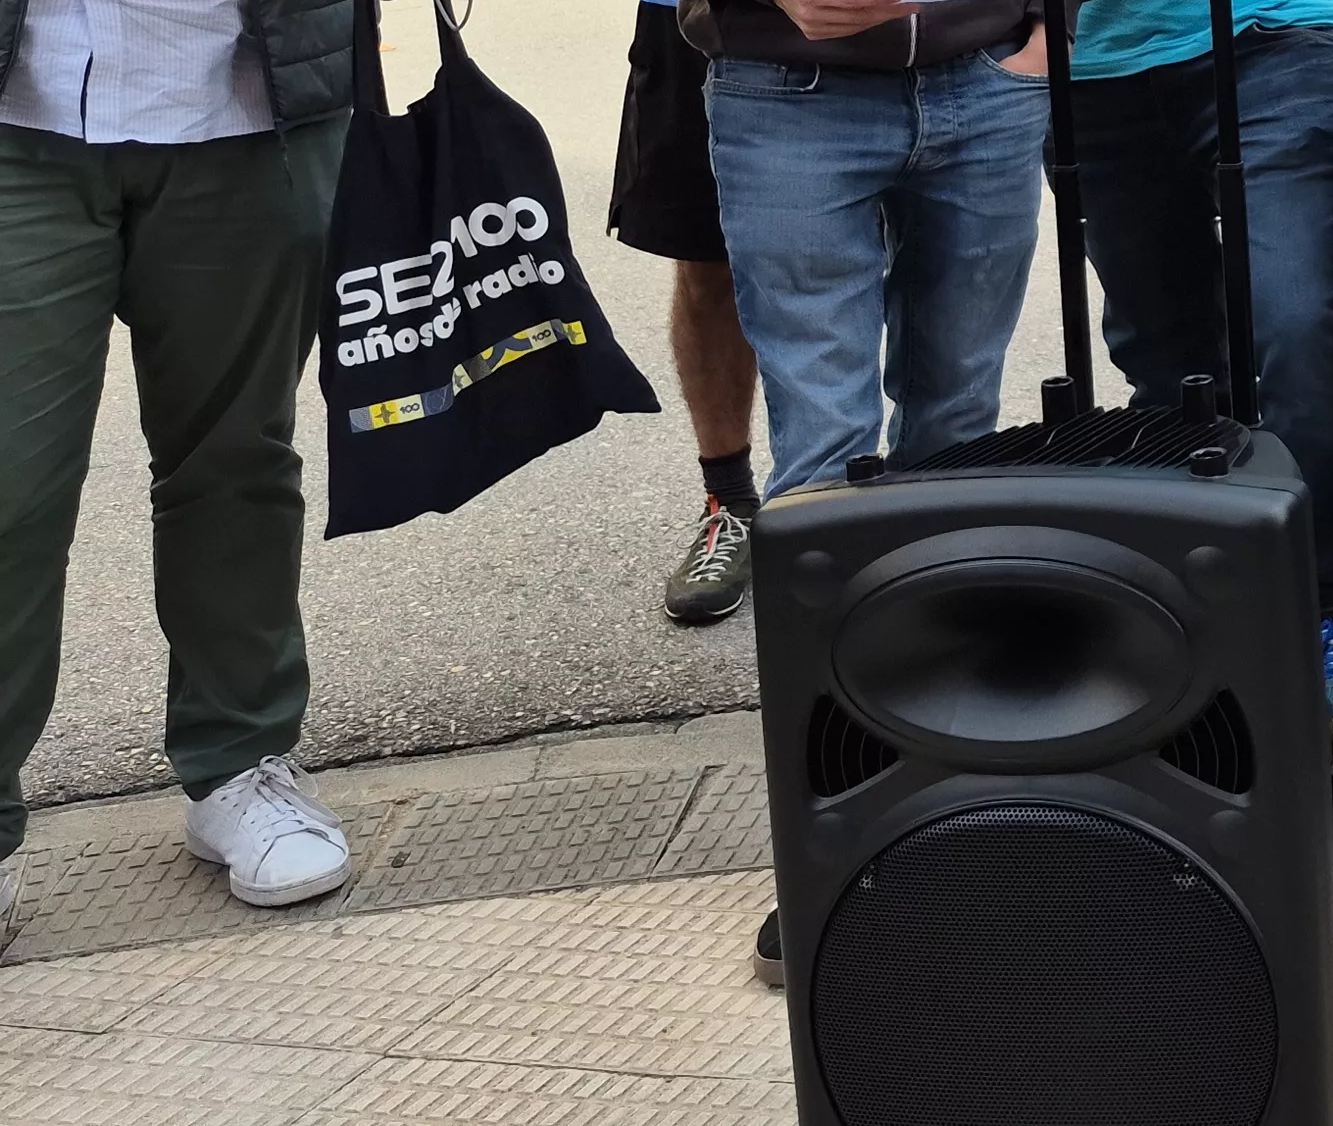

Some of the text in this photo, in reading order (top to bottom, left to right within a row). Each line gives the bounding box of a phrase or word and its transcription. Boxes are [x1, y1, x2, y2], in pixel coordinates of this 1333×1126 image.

[451, 196, 550, 259] 100
[531, 329, 552, 342] 100
[399, 402, 420, 415] 100
